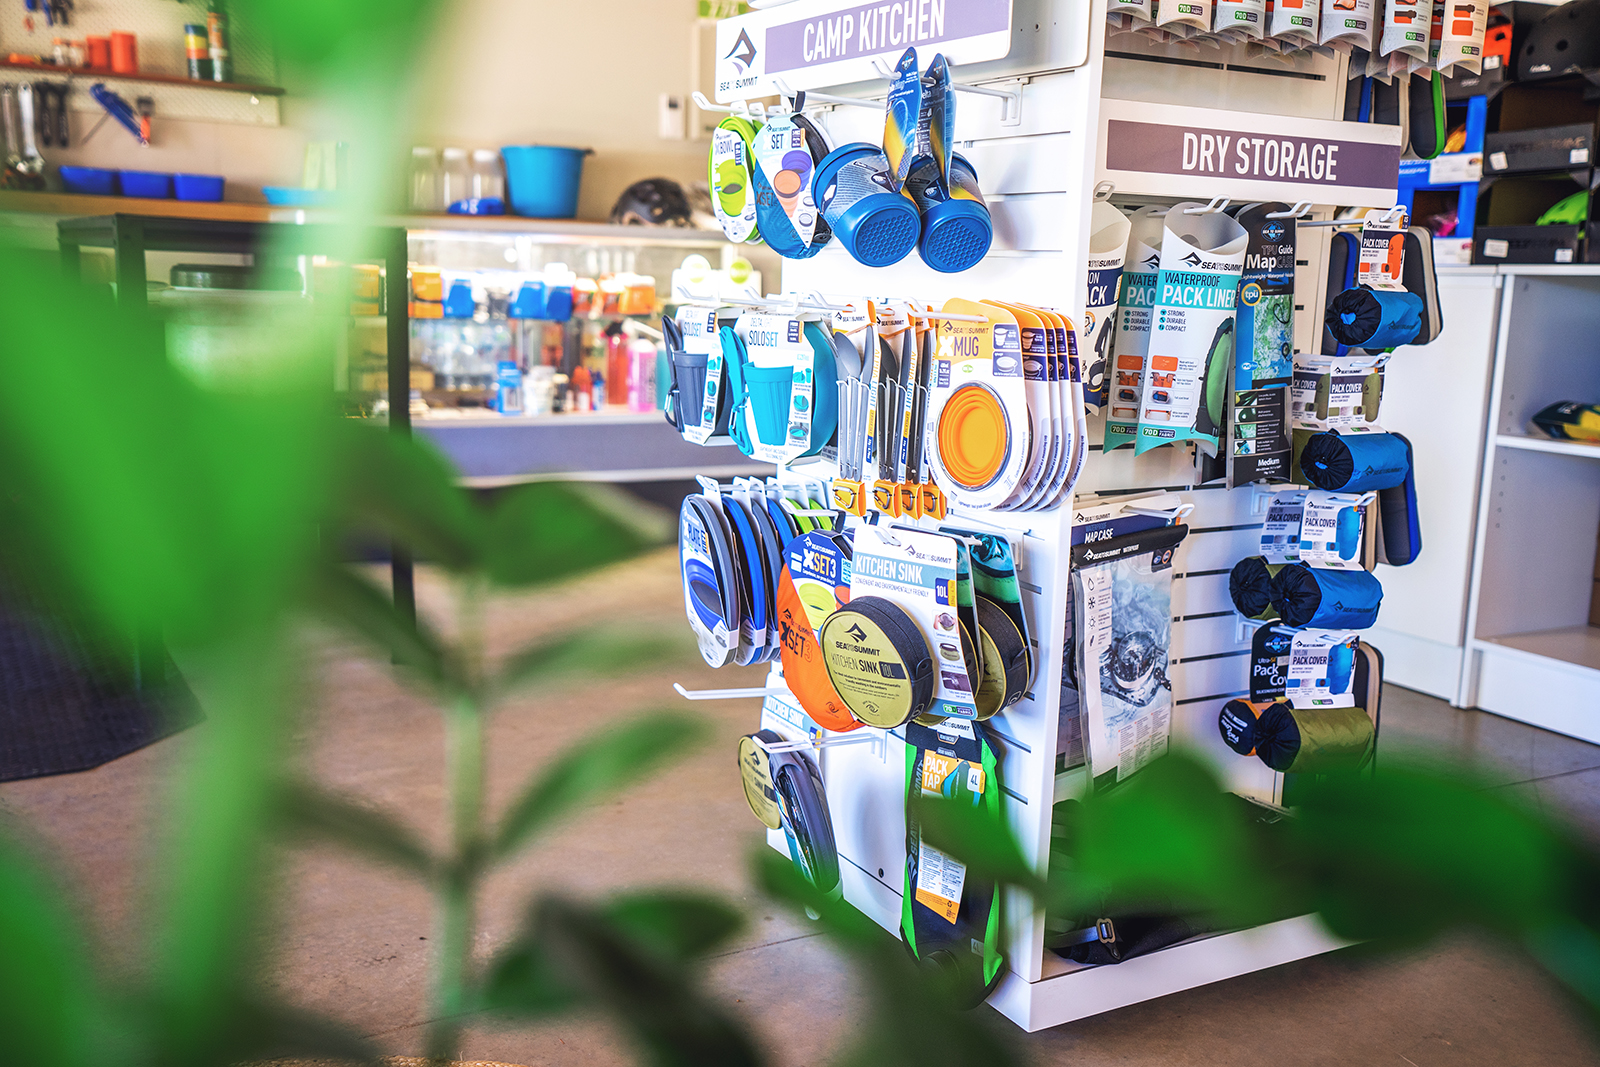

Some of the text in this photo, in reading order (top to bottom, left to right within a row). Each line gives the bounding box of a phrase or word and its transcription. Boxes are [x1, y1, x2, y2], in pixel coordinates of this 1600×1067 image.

[803, 0, 946, 63] CAMP KITCHEN
[1182, 132, 1340, 182] DRY STORAGE
[1261, 245, 1294, 255] TPU Guide
[1362, 238, 1389, 249] PACK COVER
[1246, 253, 1277, 273] Map
[1165, 272, 1221, 287] WATERPROOF
[1162, 285, 1237, 309] PACK LINER
[749, 329, 779, 348] SOLOSET
[1331, 383, 1362, 393] PACK COVER
[1144, 428, 1158, 436] 70D
[1258, 457, 1280, 467] Medium
[1268, 513, 1301, 522] PACK COVER
[1305, 518, 1336, 528] PACK COVER
[1084, 528, 1114, 544] MAP CASE
[856, 554, 897, 579] KITCHEN
[898, 562, 923, 585] SINK
[936, 585, 949, 599] 10L
[830, 652, 896, 678] KITCHEN SINK 10L
[1292, 656, 1327, 665] PACK COVER
[1253, 663, 1279, 677] Pack
[924, 755, 949, 777] PACK
[923, 771, 941, 789] TAP
[970, 774, 978, 786] 4L
